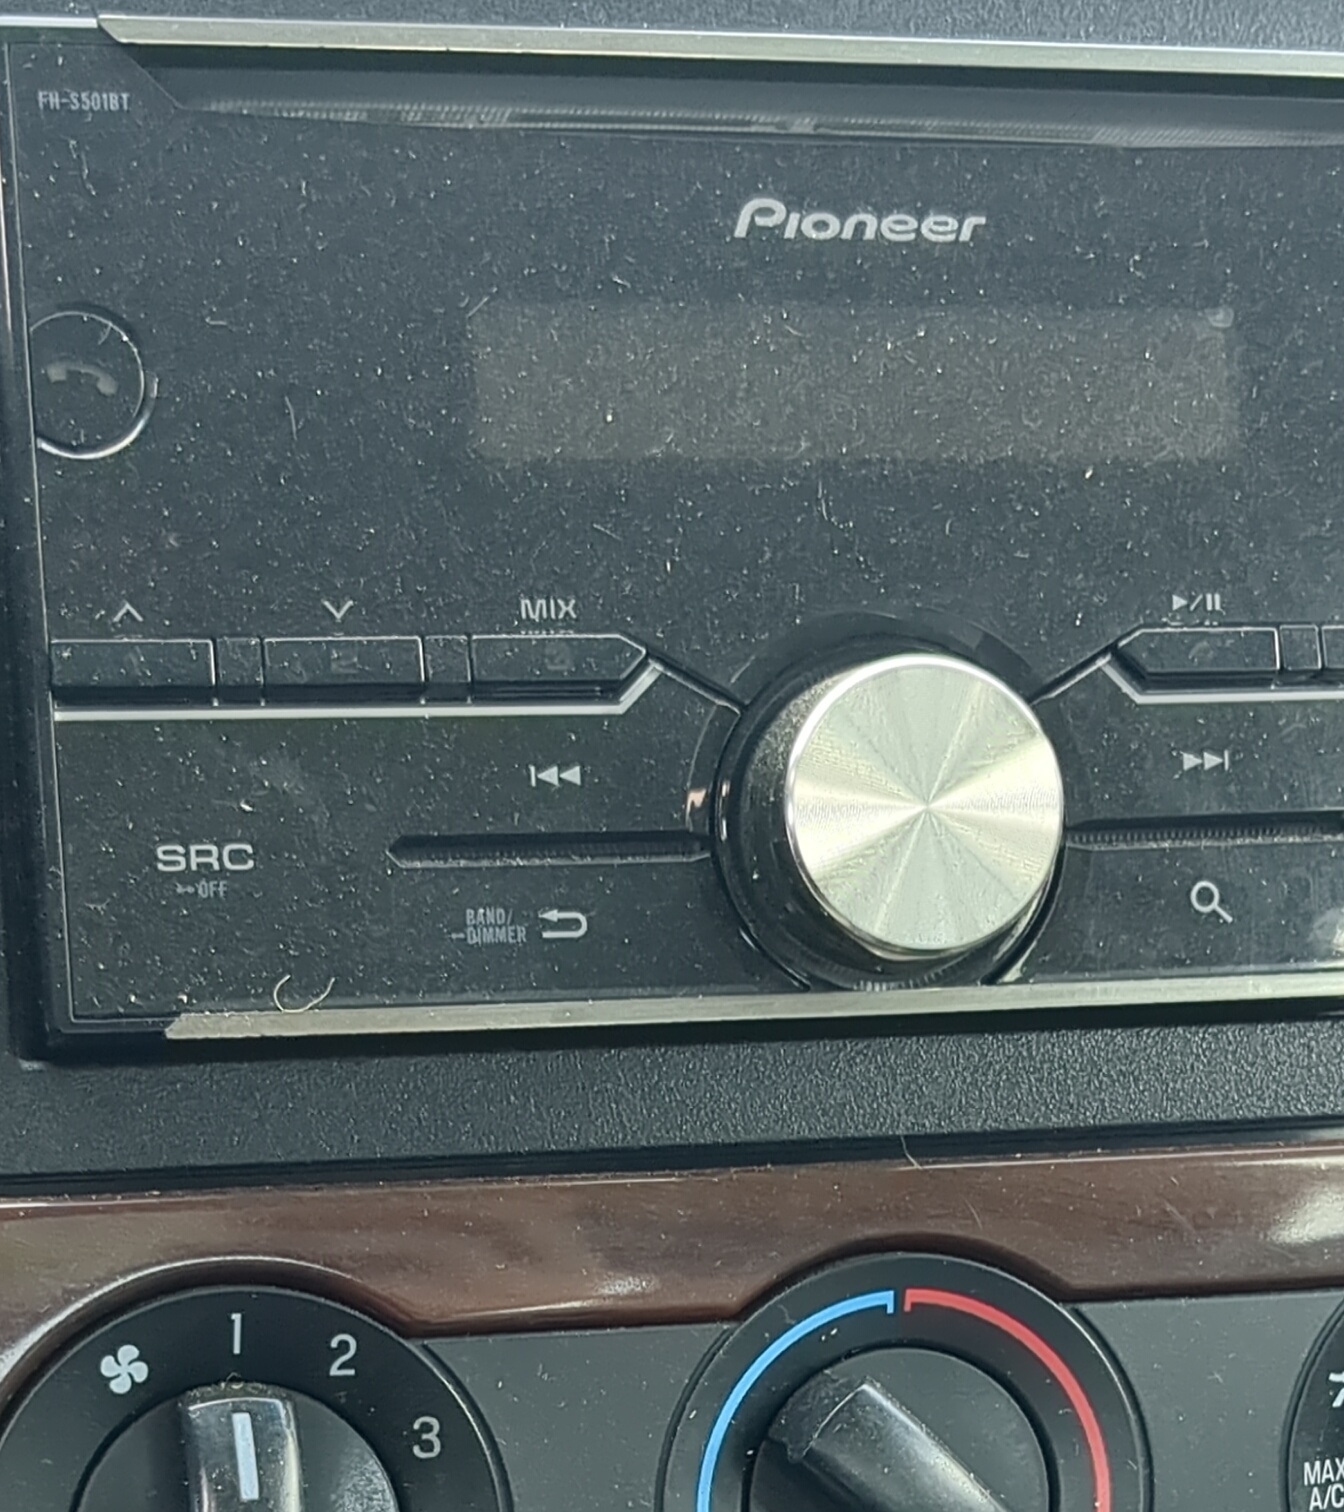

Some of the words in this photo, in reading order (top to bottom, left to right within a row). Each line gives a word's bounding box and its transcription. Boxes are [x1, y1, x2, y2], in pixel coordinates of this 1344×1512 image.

[733, 197, 987, 242] Pioneer
[520, 597, 577, 621] MIX
[156, 843, 255, 872] SRC
[229, 1312, 245, 1356] 1
[328, 1335, 357, 1377] 2
[411, 1416, 442, 1459] 3
